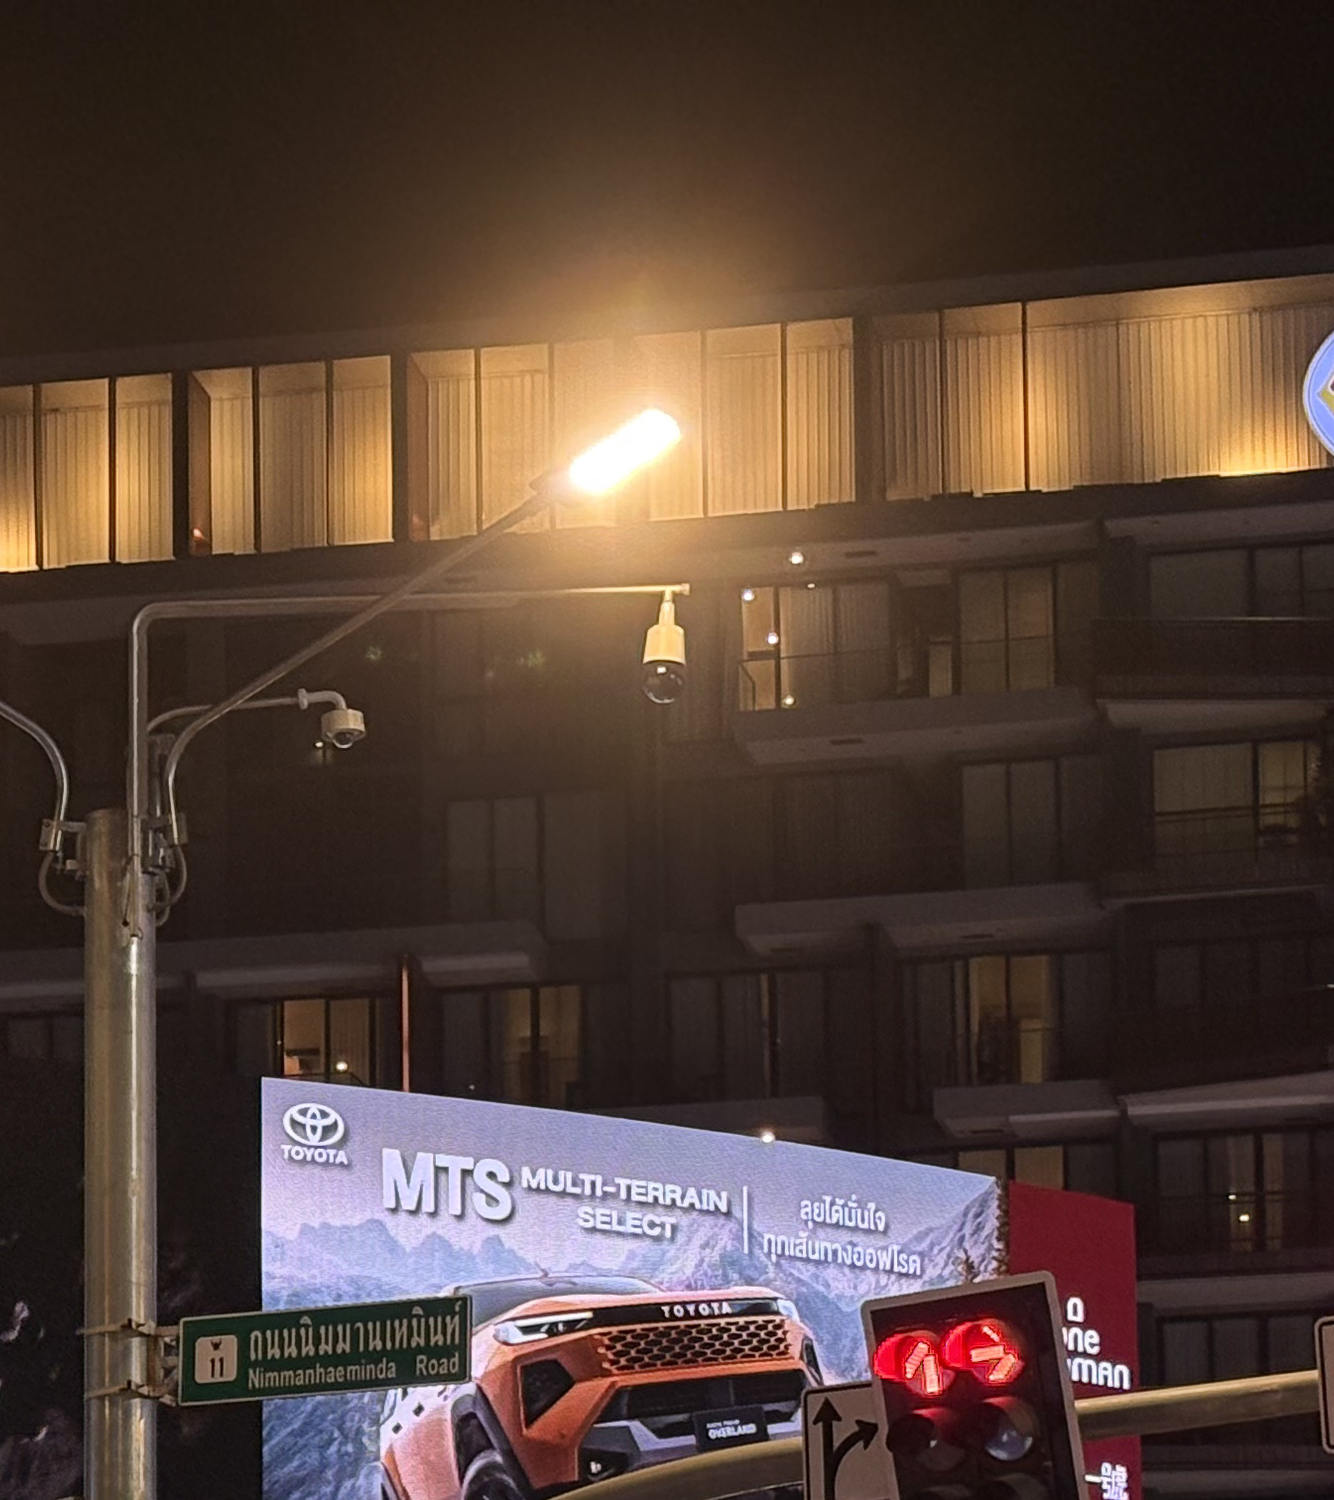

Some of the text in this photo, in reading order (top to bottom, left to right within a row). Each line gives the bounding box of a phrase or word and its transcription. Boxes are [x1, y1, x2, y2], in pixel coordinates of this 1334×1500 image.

[281, 1144, 348, 1165] TOYOTA
[381, 1147, 513, 1221] MTS
[520, 1165, 729, 1214] MULTI-TERRAIN
[576, 1206, 677, 1240] SELECT
[661, 1301, 732, 1318] TOYOTA
[249, 1301, 463, 1362] ถนนนิมมานเหมินท์
[248, 1352, 460, 1390] Nimmanhaeminda Road
